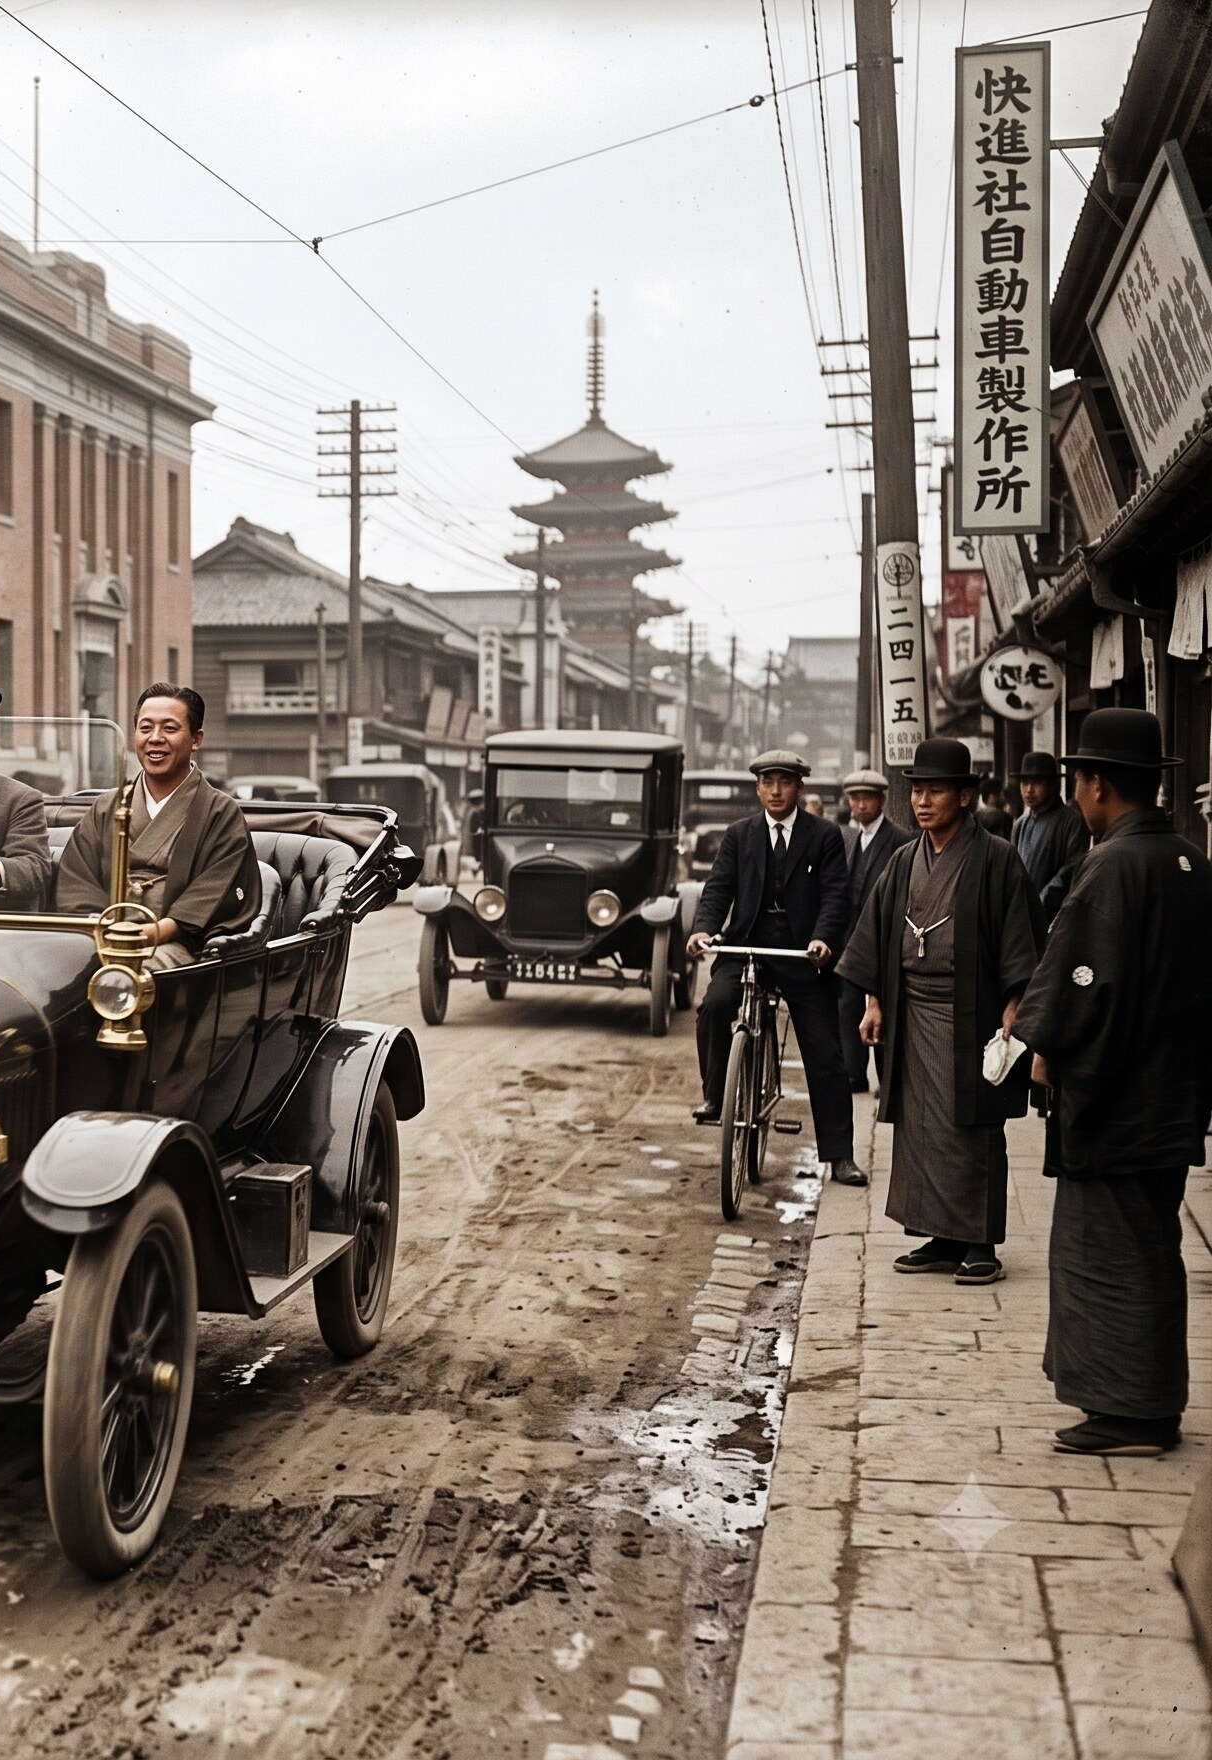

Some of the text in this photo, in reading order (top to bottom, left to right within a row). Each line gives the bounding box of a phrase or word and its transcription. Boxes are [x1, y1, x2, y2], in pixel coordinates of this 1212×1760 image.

[972, 65, 1033, 514] 快進社自動車製作所
[886, 606, 919, 724] 二四一五
